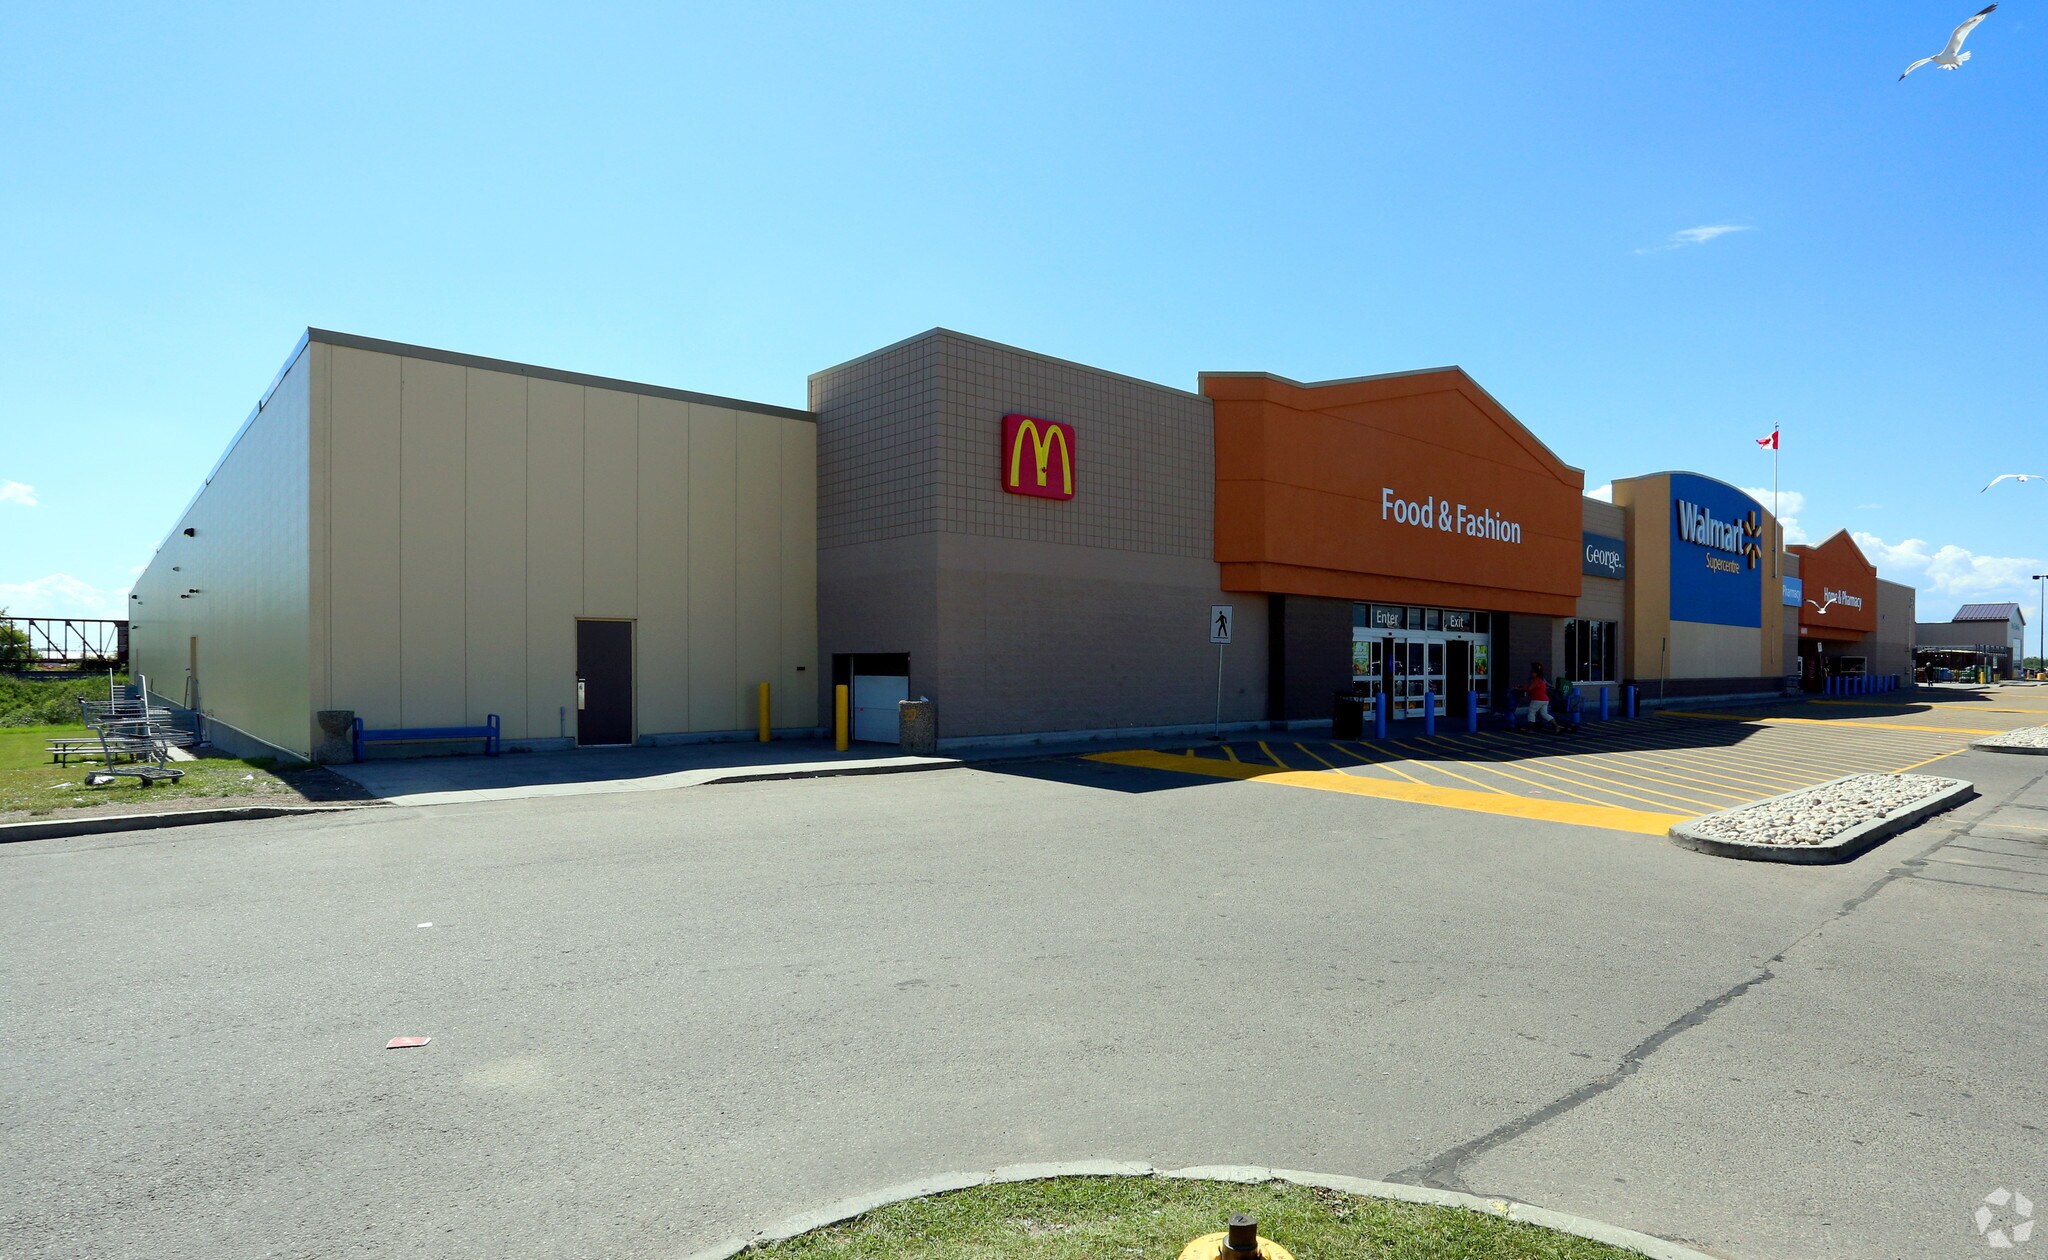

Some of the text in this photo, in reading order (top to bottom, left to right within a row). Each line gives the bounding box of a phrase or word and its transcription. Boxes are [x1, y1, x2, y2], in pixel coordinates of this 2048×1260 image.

[1382, 487, 1521, 544] Food & Fashion
[1679, 499, 1744, 555] Walmart
[1705, 552, 1740, 574] Supercentre
[1842, 590, 1862, 612] Pharmacy
[1376, 610, 1399, 625] Enter
[1450, 615, 1464, 628] Exit
